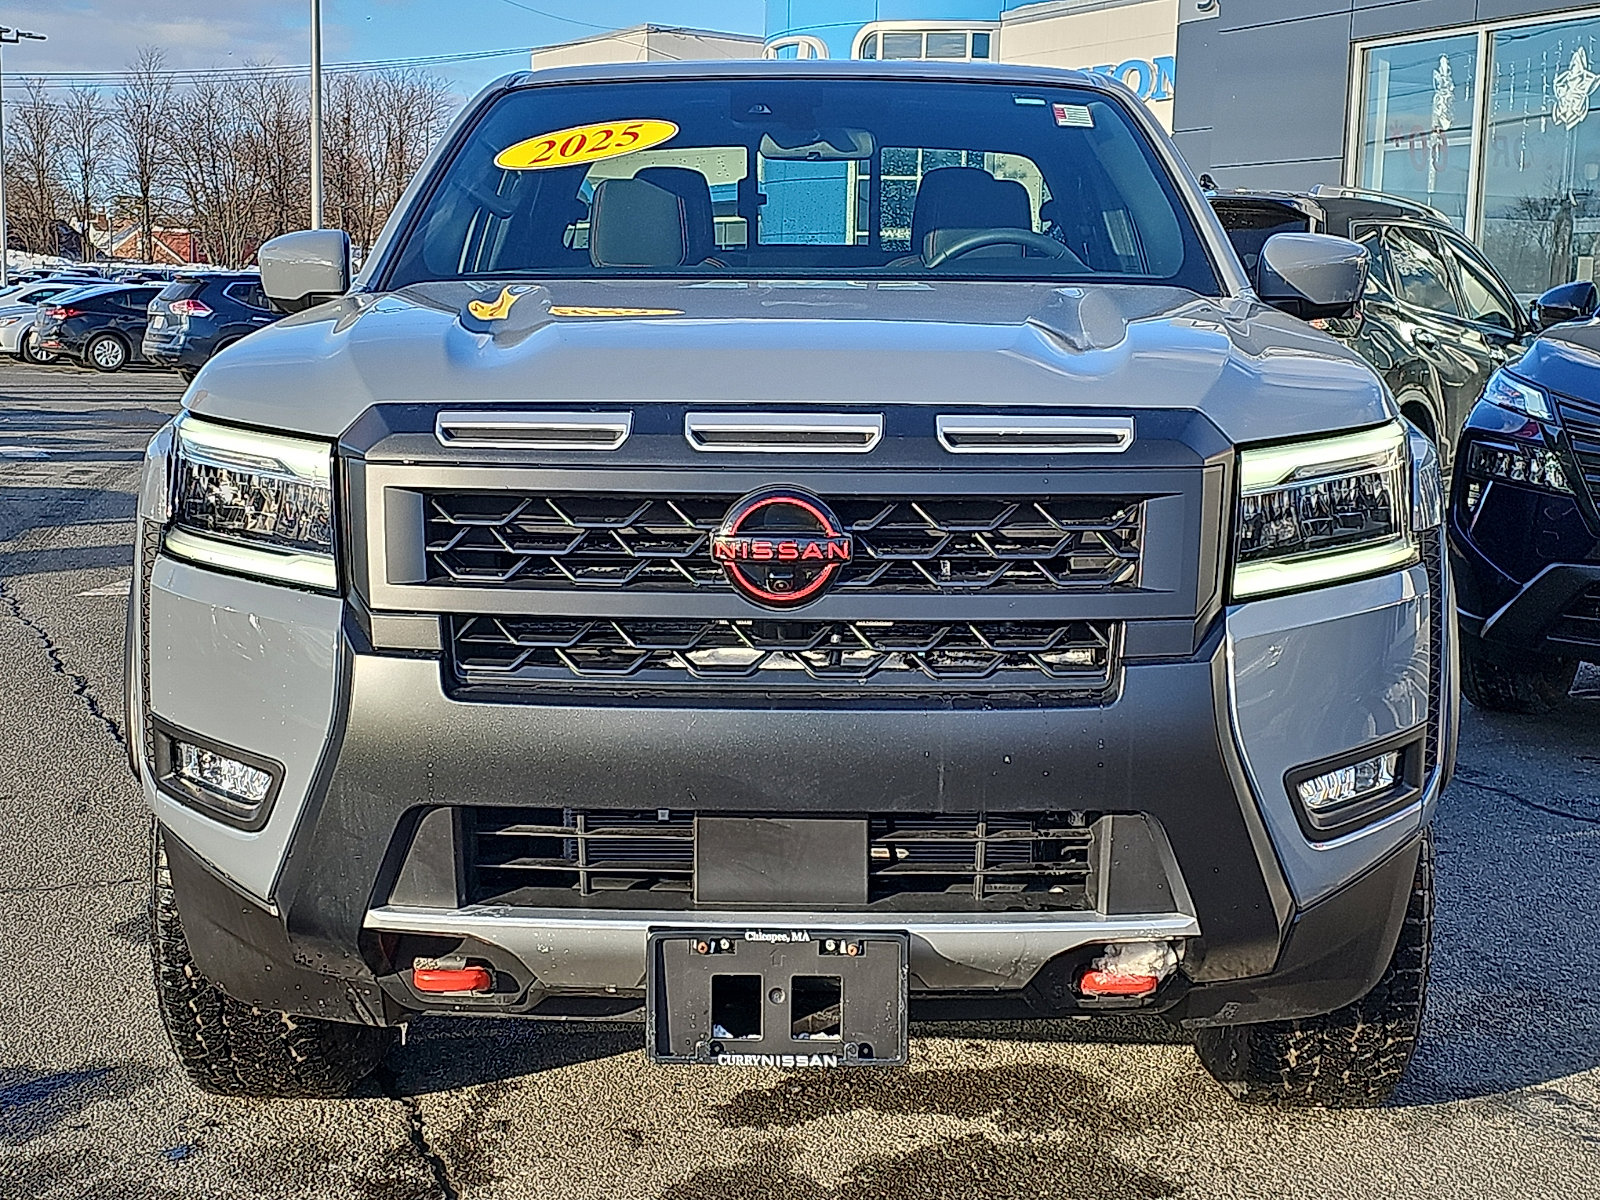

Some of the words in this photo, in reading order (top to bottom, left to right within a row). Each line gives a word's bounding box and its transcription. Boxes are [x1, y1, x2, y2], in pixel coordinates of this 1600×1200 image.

[528, 123, 644, 165] 2025
[714, 540, 850, 560] NISSAN
[745, 931, 790, 944] Chicopee,
[791, 931, 811, 942] MA
